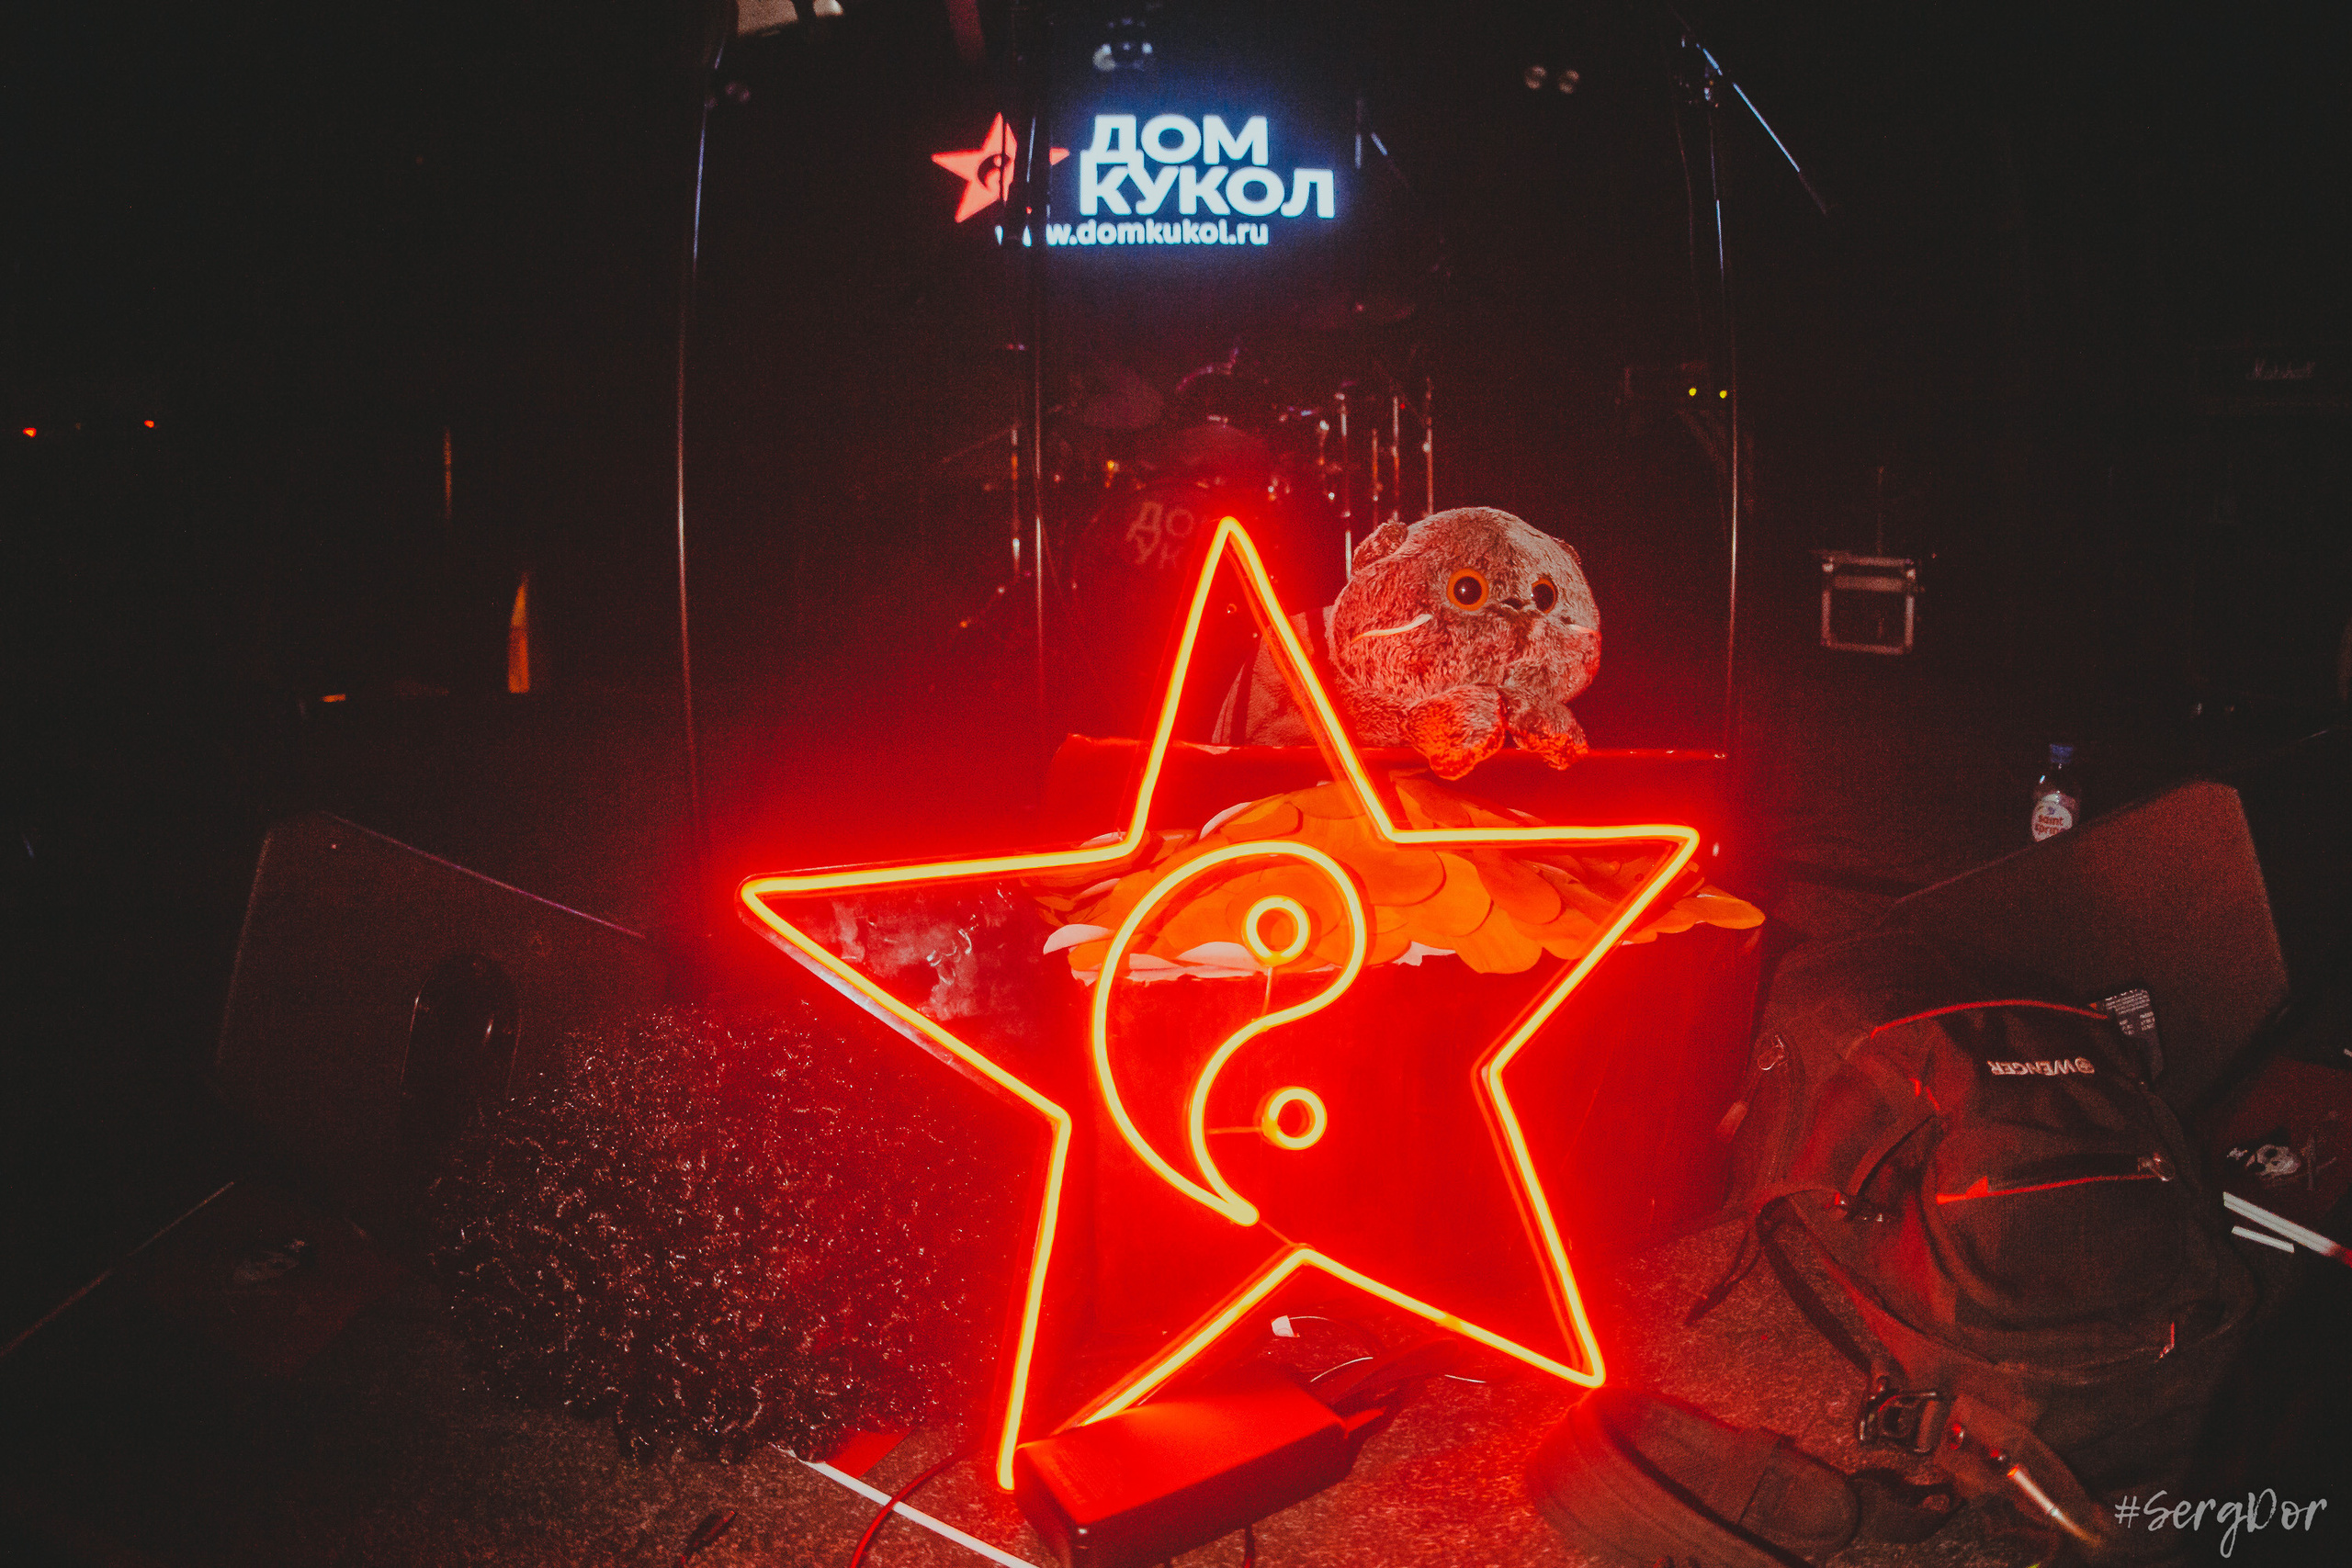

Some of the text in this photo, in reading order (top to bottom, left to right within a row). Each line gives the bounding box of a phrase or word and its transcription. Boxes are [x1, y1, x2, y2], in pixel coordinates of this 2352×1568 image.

[1080, 114, 1269, 165] ДОМ
[1080, 165, 1335, 218] КУКОЛ
[994, 219, 1269, 247] w.domkukol.ru
[1125, 501, 1195, 543] ДО
[1987, 1059, 2077, 1076] WENGER
